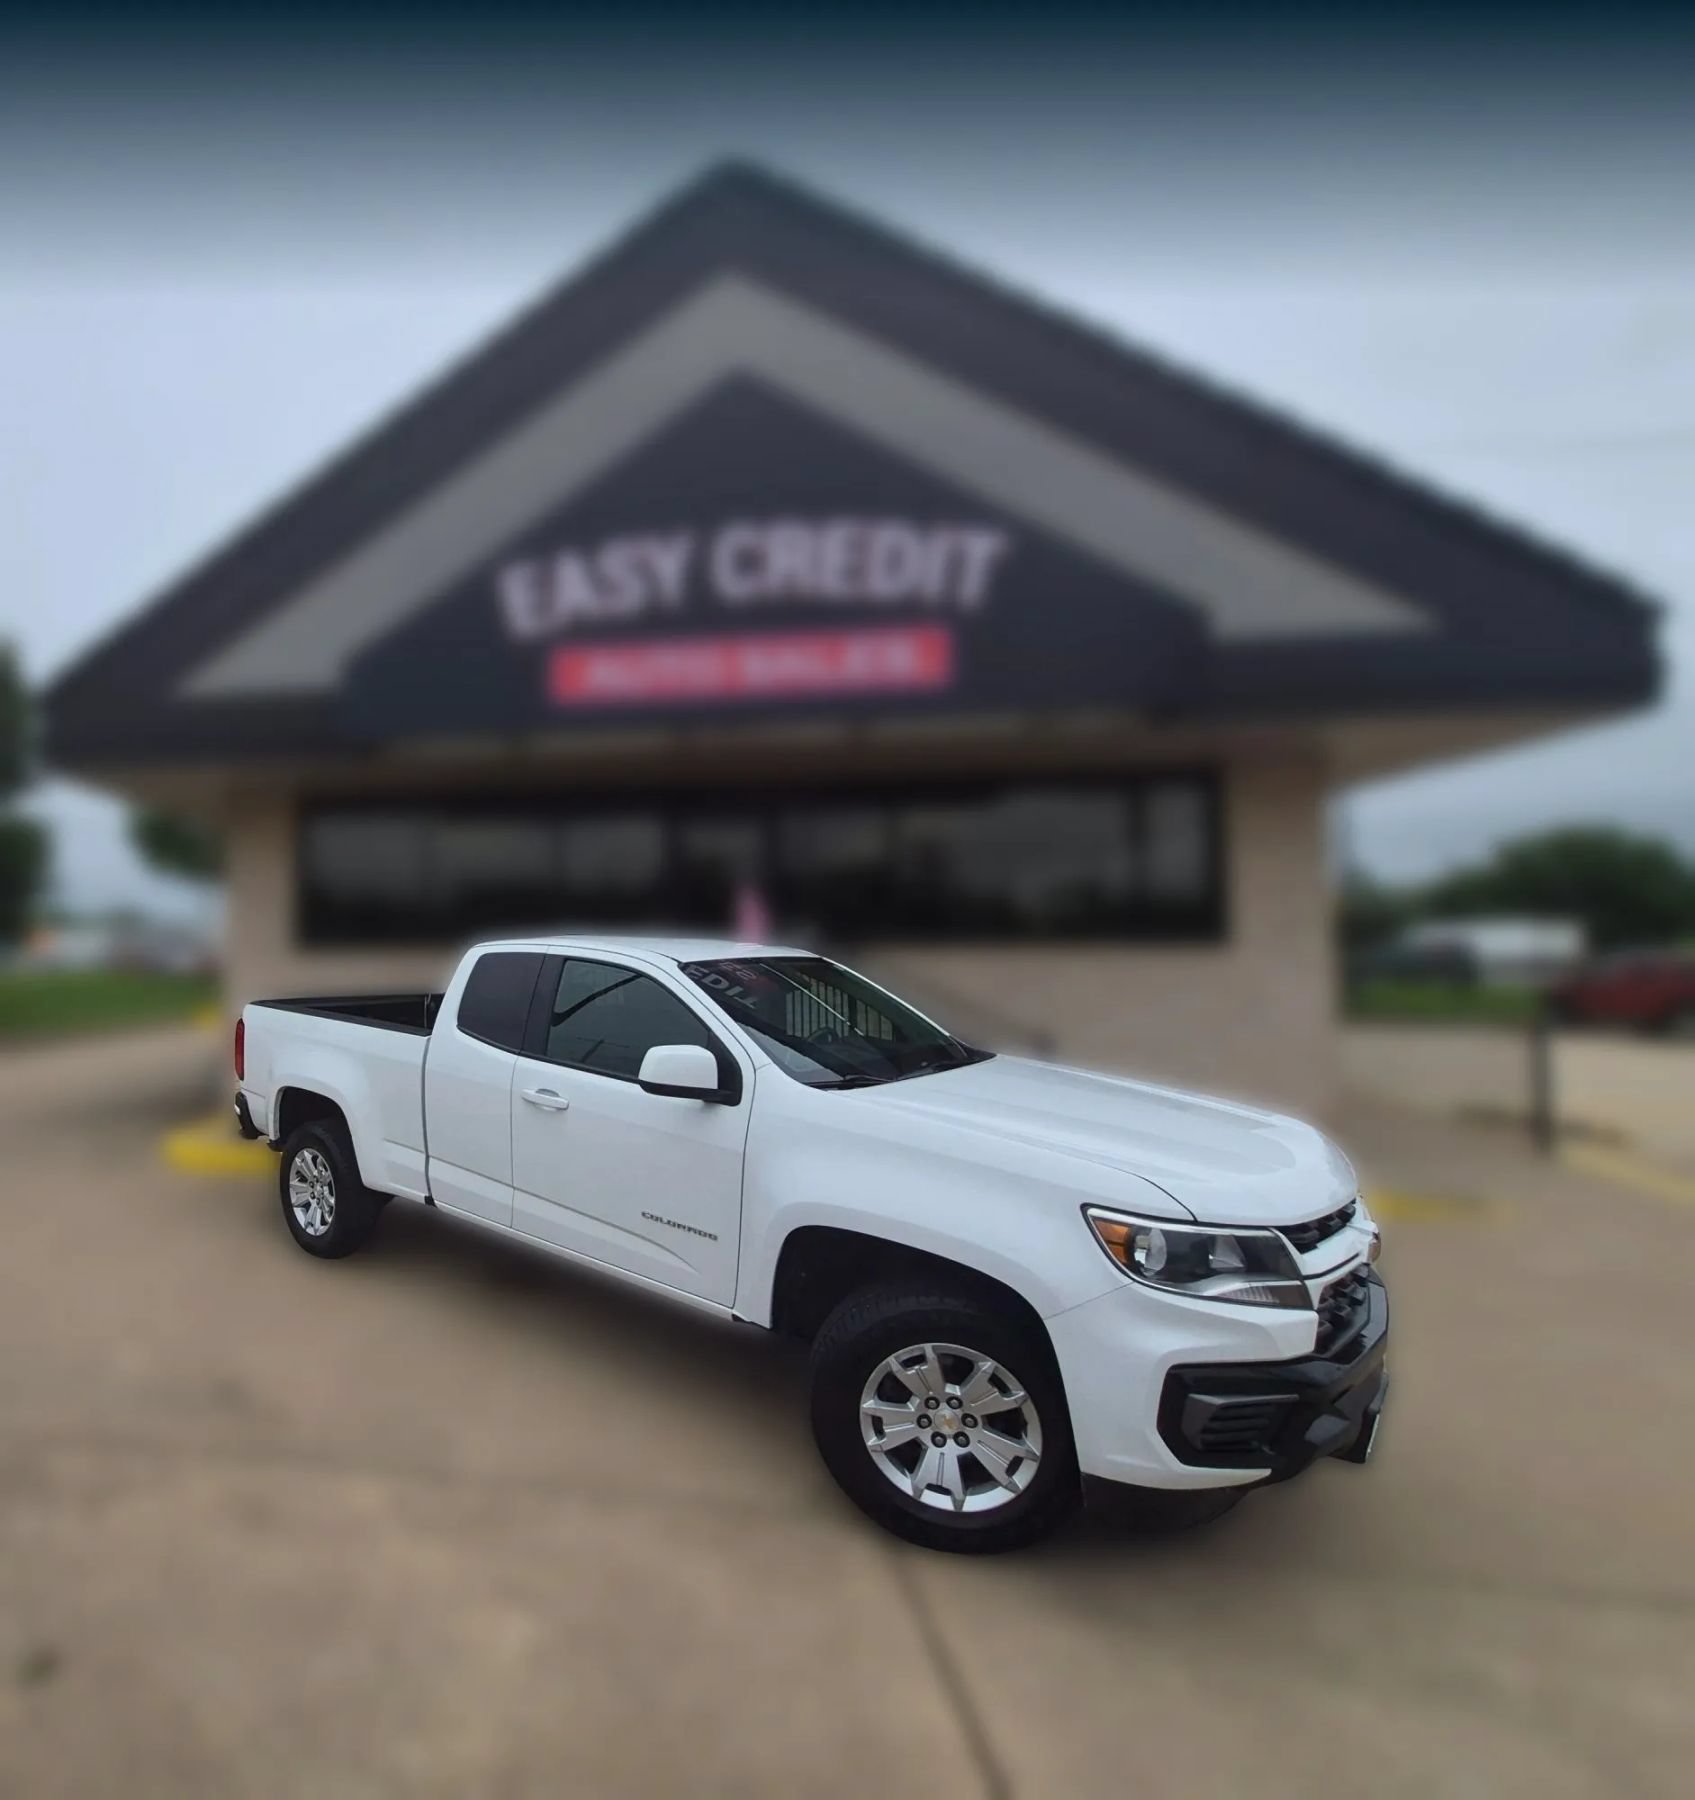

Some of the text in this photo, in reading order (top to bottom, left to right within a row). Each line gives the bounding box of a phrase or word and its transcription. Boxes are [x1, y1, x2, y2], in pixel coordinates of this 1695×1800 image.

[500, 517, 1006, 640] EASY CREDIT
[641, 1211, 718, 1241] COLORADO
